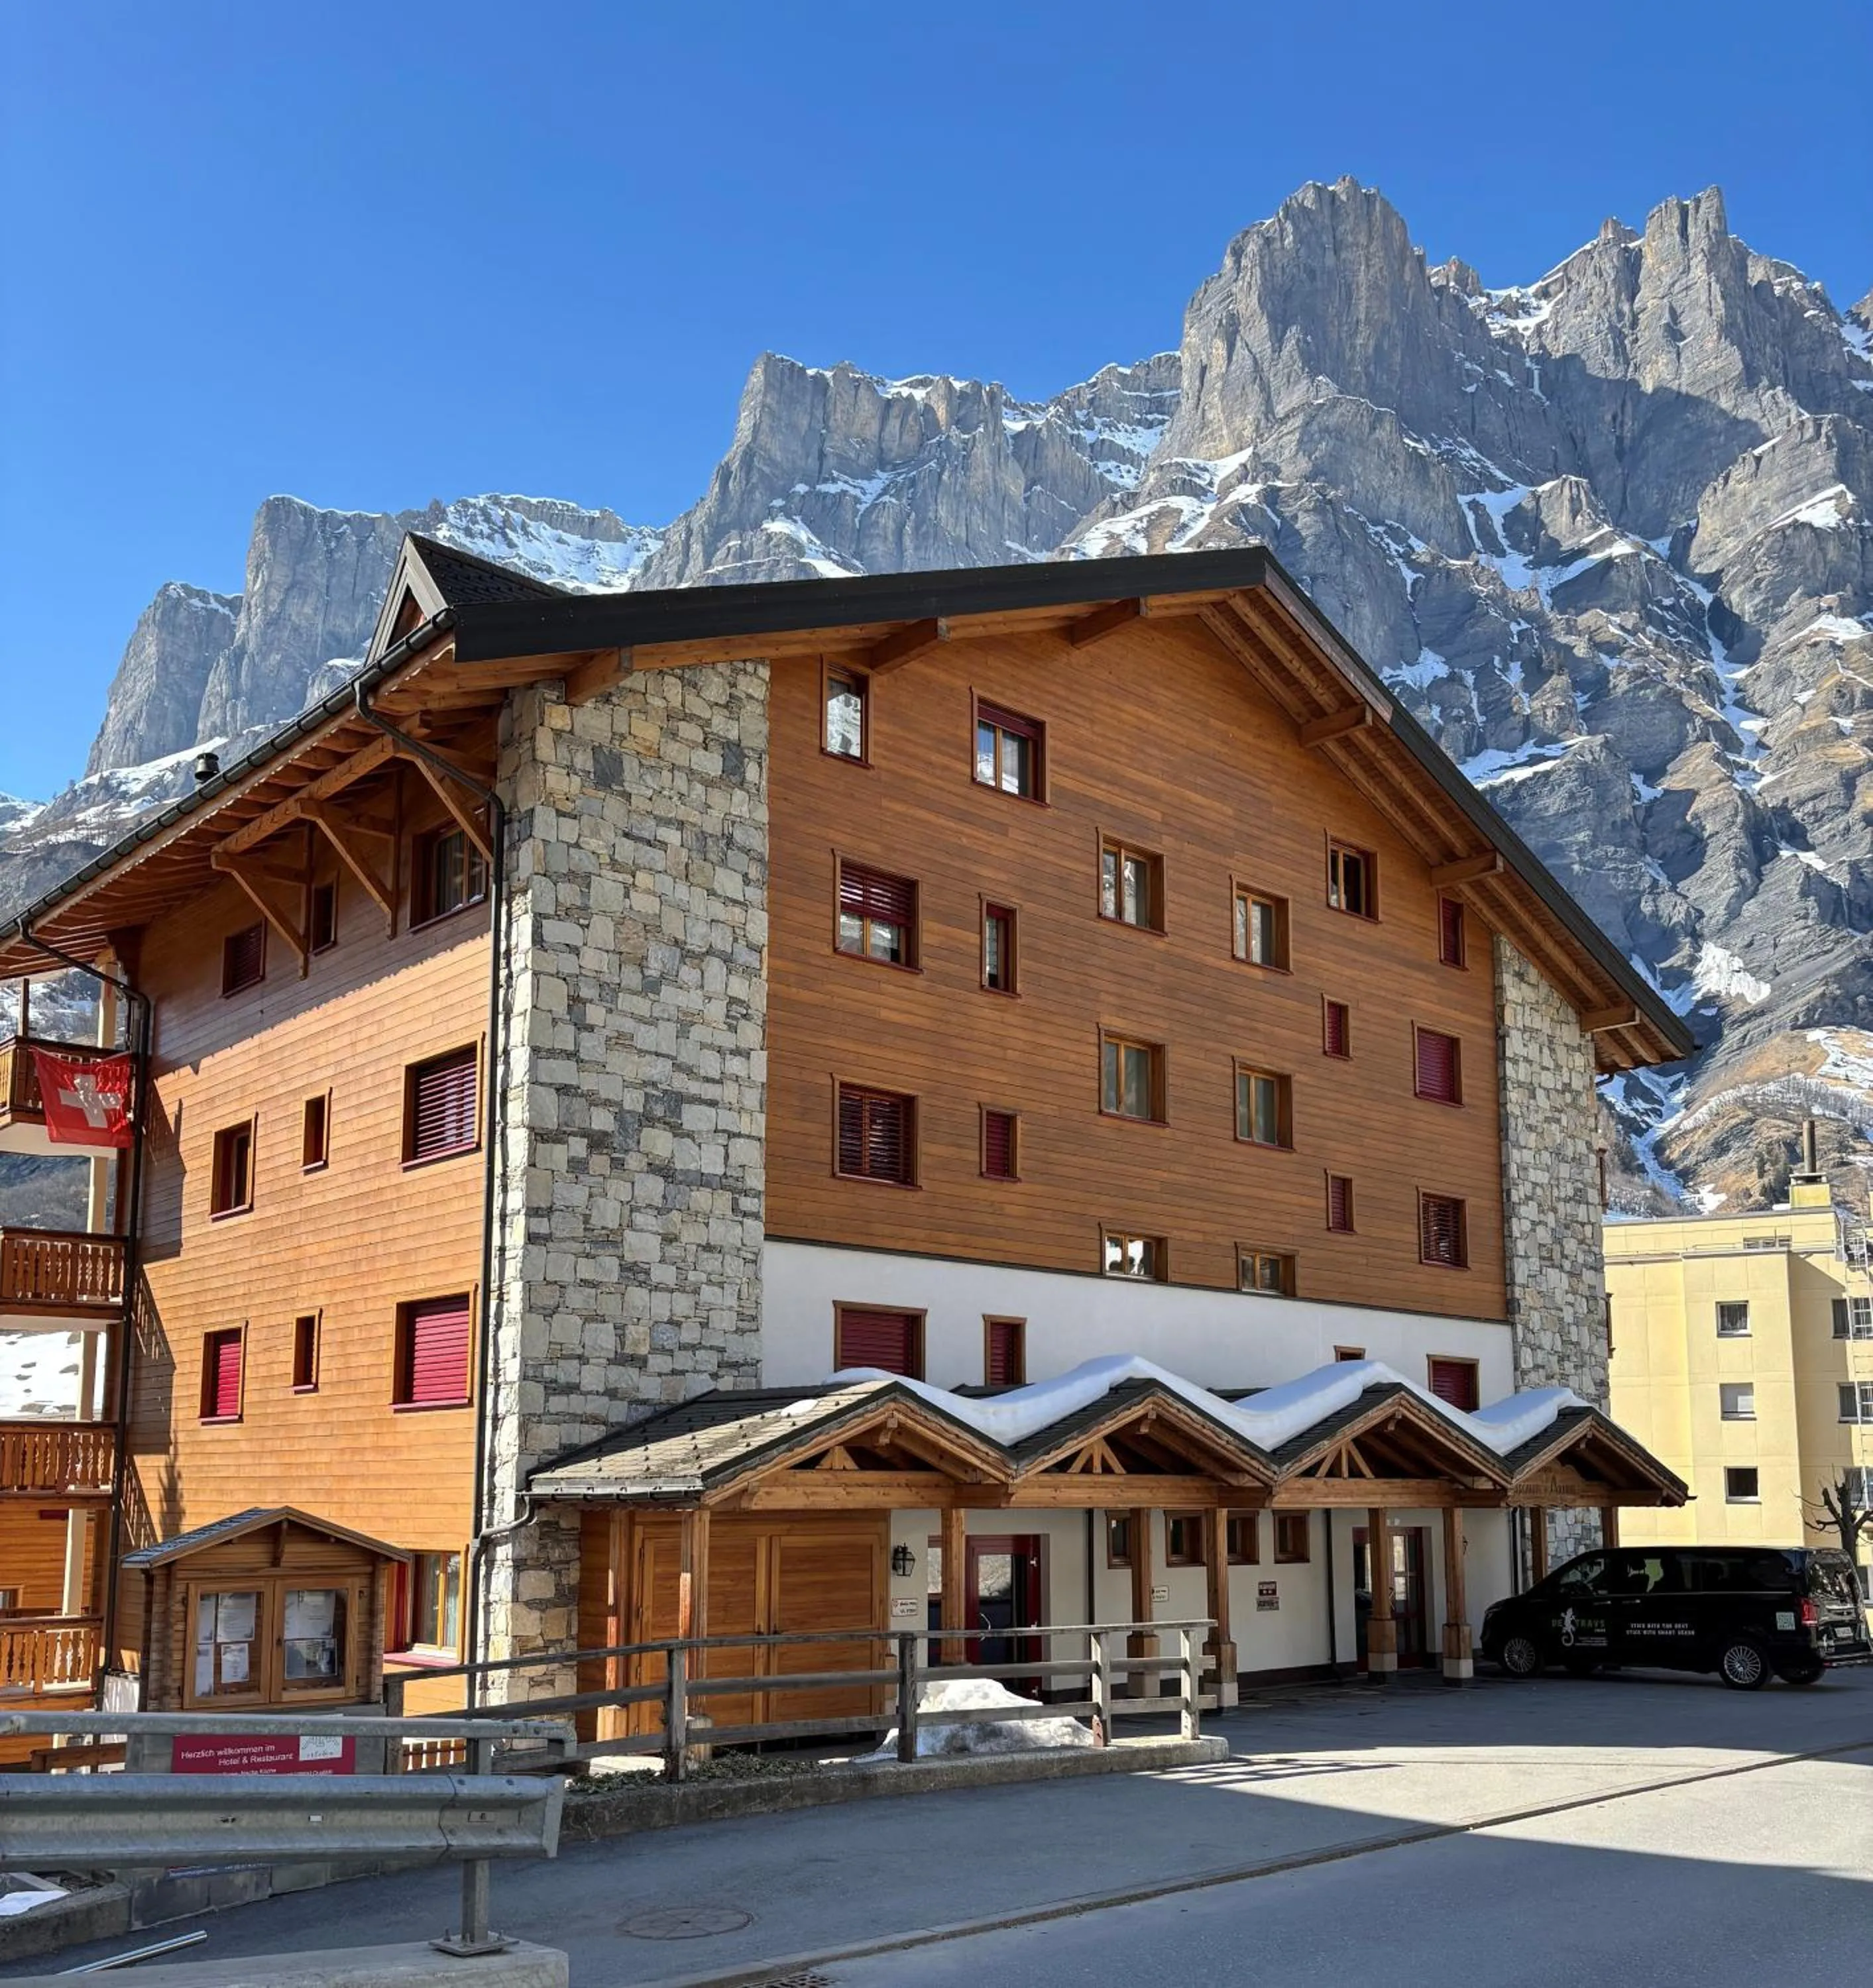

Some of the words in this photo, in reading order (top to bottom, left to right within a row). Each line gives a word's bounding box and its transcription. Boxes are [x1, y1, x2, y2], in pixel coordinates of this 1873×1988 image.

[181, 1749, 215, 1759] Herzlich
[217, 1745, 263, 1756] willkommen
[218, 1757, 240, 1766] Hotel
[242, 1755, 249, 1764] &
[250, 1753, 294, 1763] Restaurant
